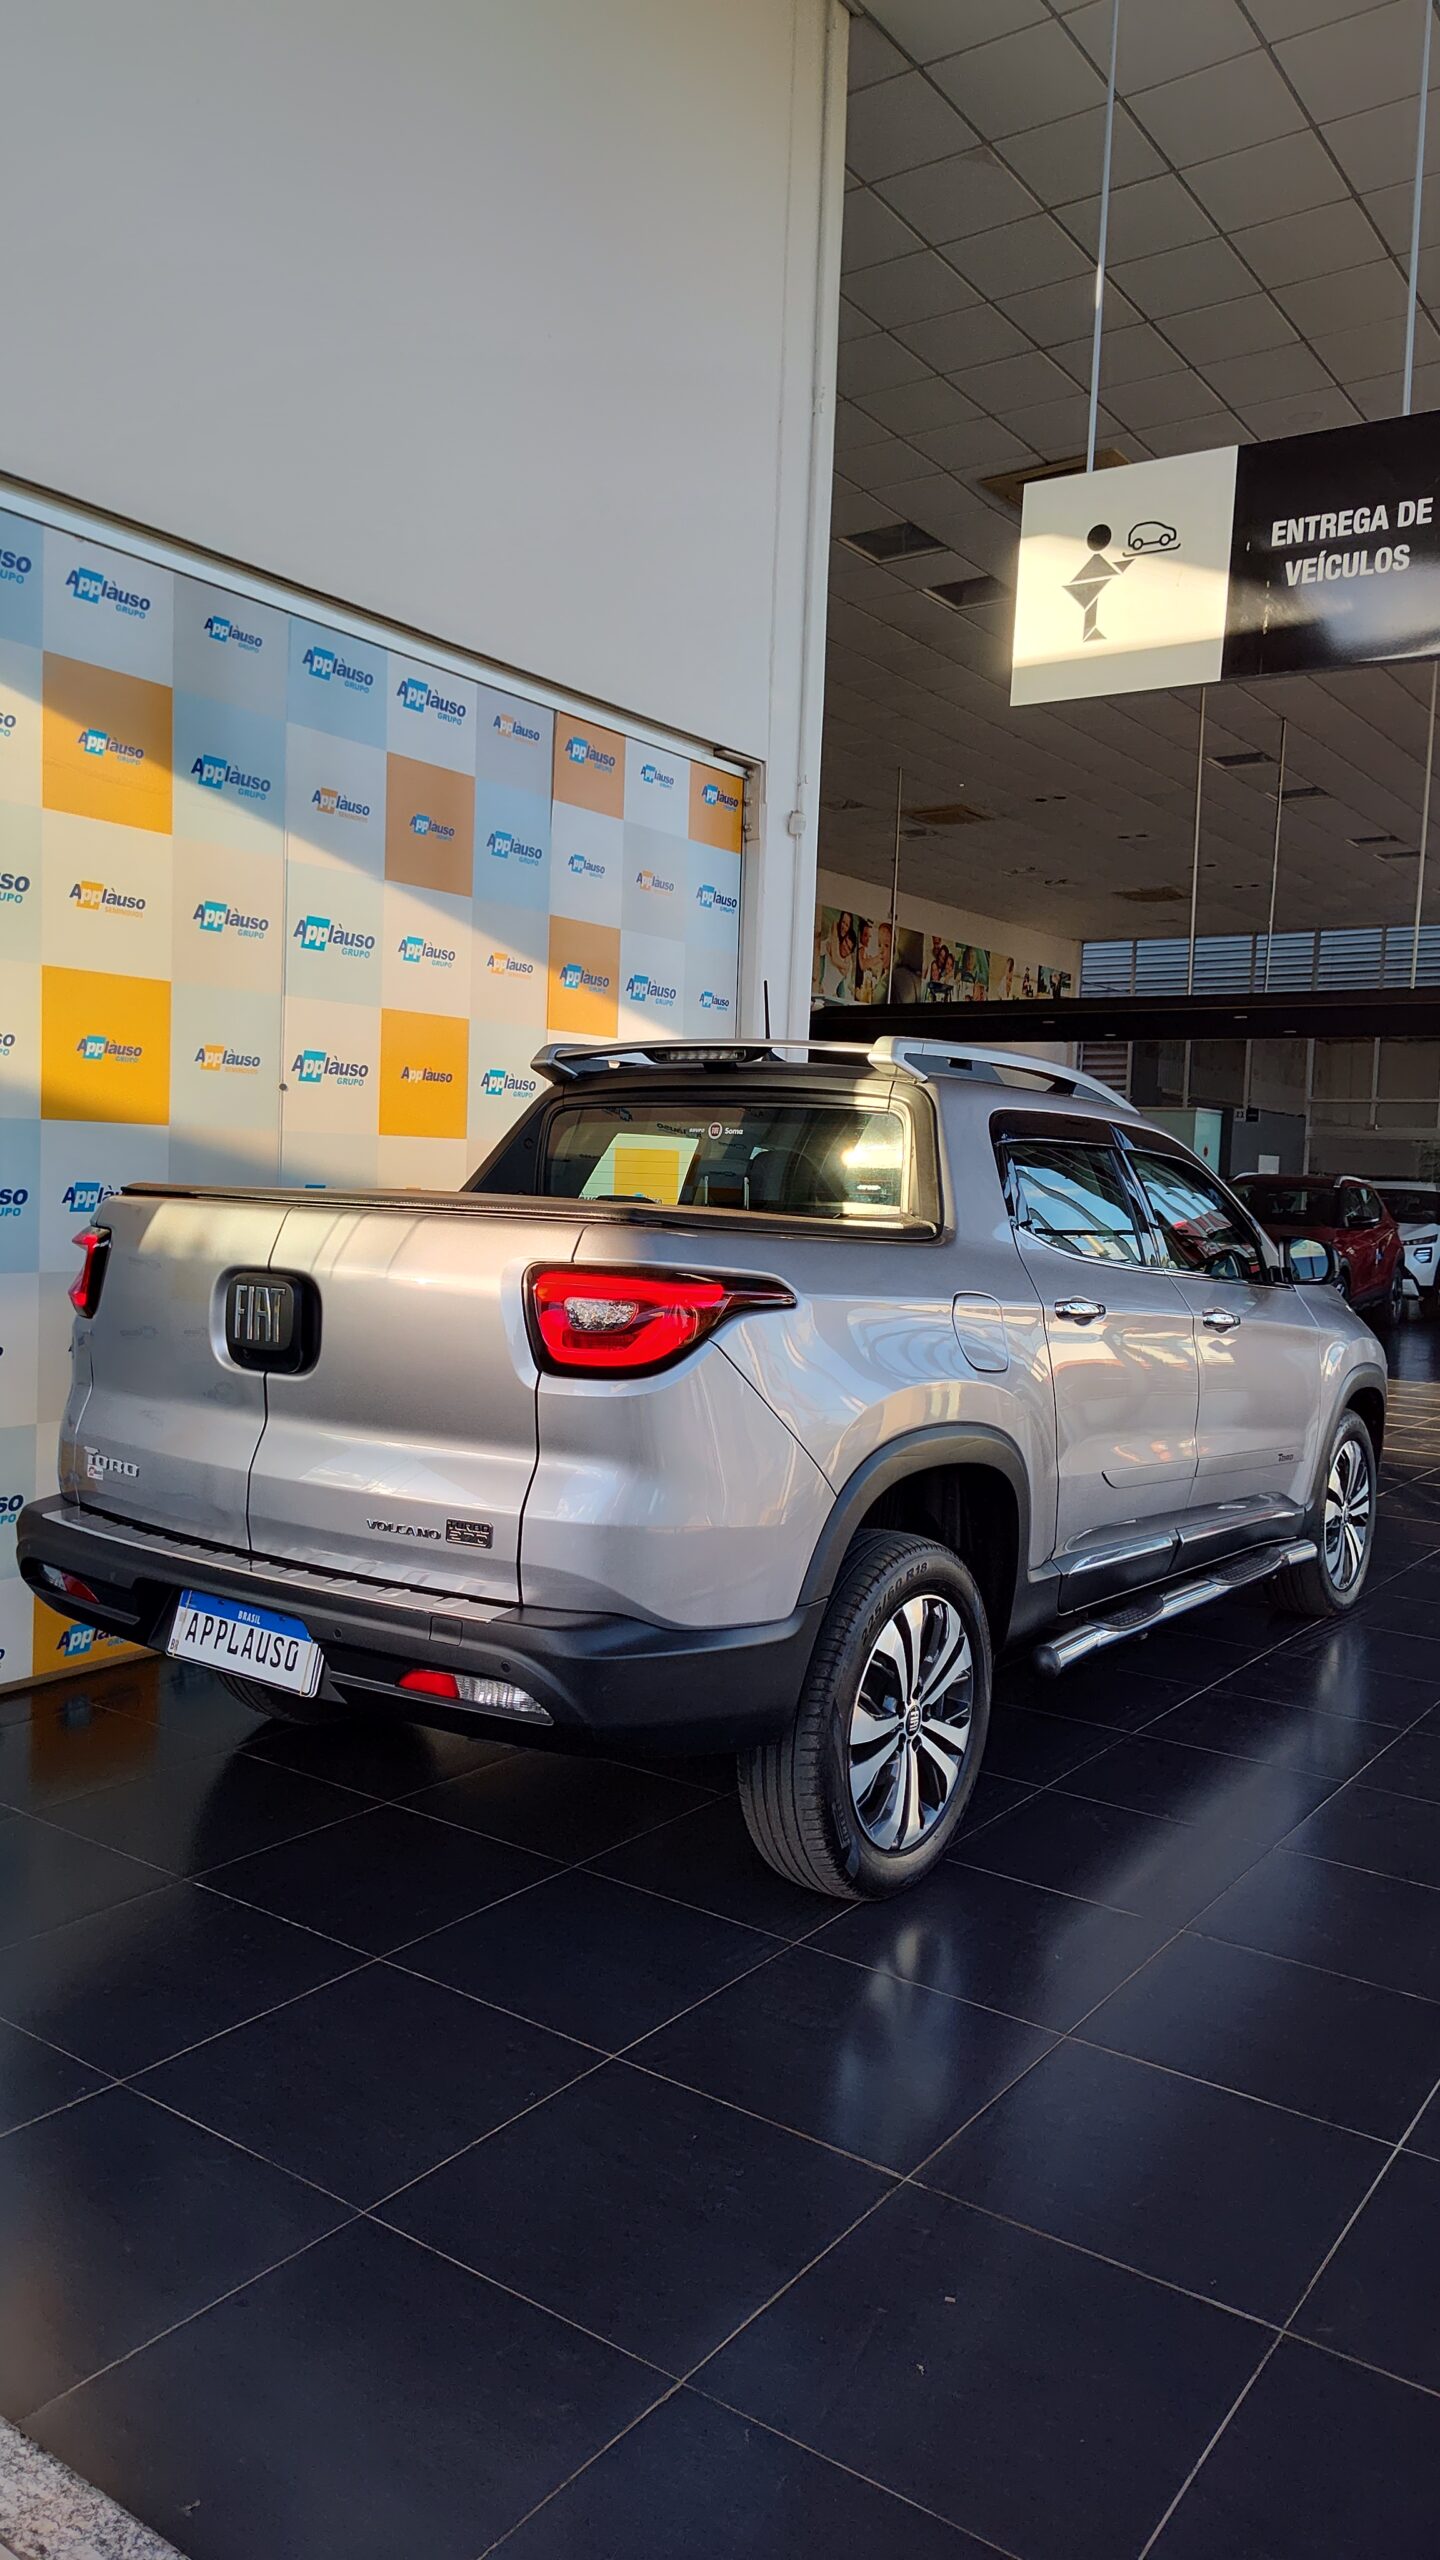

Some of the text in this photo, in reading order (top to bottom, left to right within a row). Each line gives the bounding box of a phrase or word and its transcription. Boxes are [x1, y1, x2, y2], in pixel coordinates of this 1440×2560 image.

[1270, 497, 1434, 547] ENTREGA DE
[1285, 543, 1411, 587] VEÍCULOS
[0, 570, 25, 584] UPO
[115, 604, 146, 619] GRUPO
[344, 680, 370, 693] GRUPO
[437, 712, 462, 726] GRUPO
[238, 788, 266, 800] GRUPO
[0, 891, 23, 904] UPO
[237, 928, 264, 939] GRUPO
[341, 947, 370, 958] GRUPO
[431, 959, 452, 968] GRUPO
[655, 998, 673, 1006] GRUPO
[336, 1077, 364, 1086] GRUPO
[513, 1091, 533, 1099] GRUPO
[724, 1127, 744, 1135] Soma
[234, 1284, 286, 1343] FIAT
[84, 1446, 140, 1477] TORO
[366, 1518, 442, 1540] VOLCANO
[447, 1520, 490, 1534] TURBO
[906, 1562, 928, 1582] R18
[237, 1610, 261, 1625] BRASIL
[185, 1612, 299, 1672] APPLAUSO
